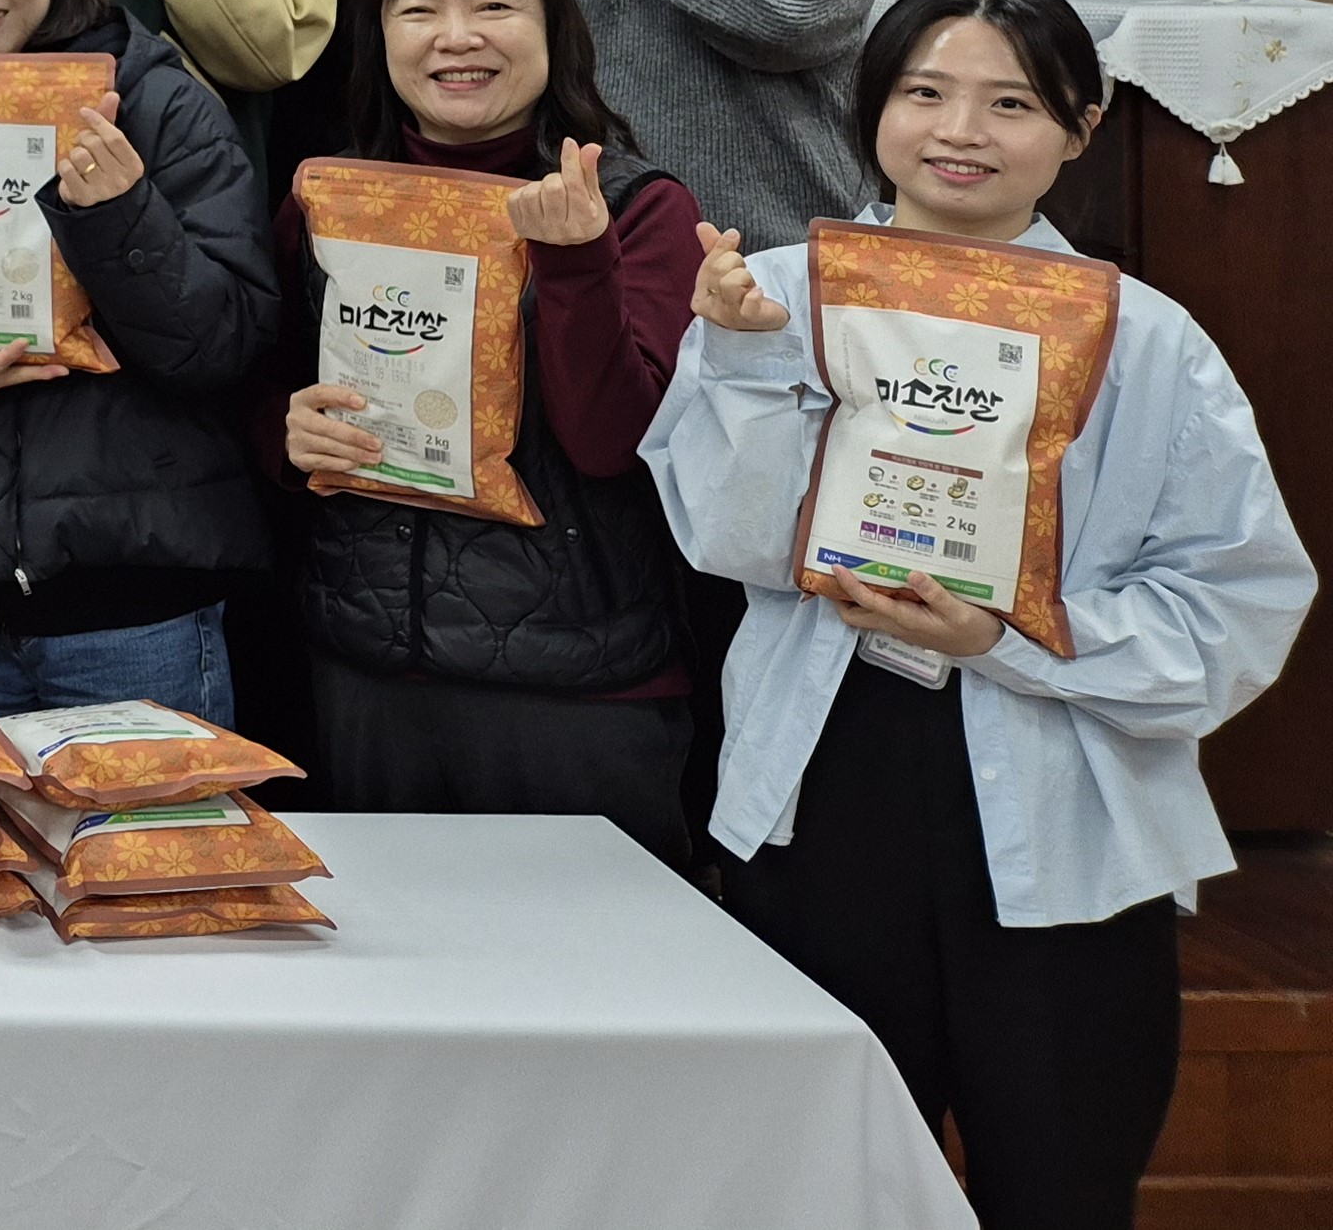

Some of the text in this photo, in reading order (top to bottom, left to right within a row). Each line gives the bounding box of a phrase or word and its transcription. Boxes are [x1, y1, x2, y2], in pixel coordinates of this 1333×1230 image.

[11, 289, 19, 302] 2
[20, 290, 33, 303] kg
[339, 304, 448, 341] 미소진쌀
[874, 376, 1004, 422] 미소진쌀
[425, 433, 450, 451] 2 kg
[946, 515, 977, 536] 2 kg
[823, 551, 842, 564] NH
